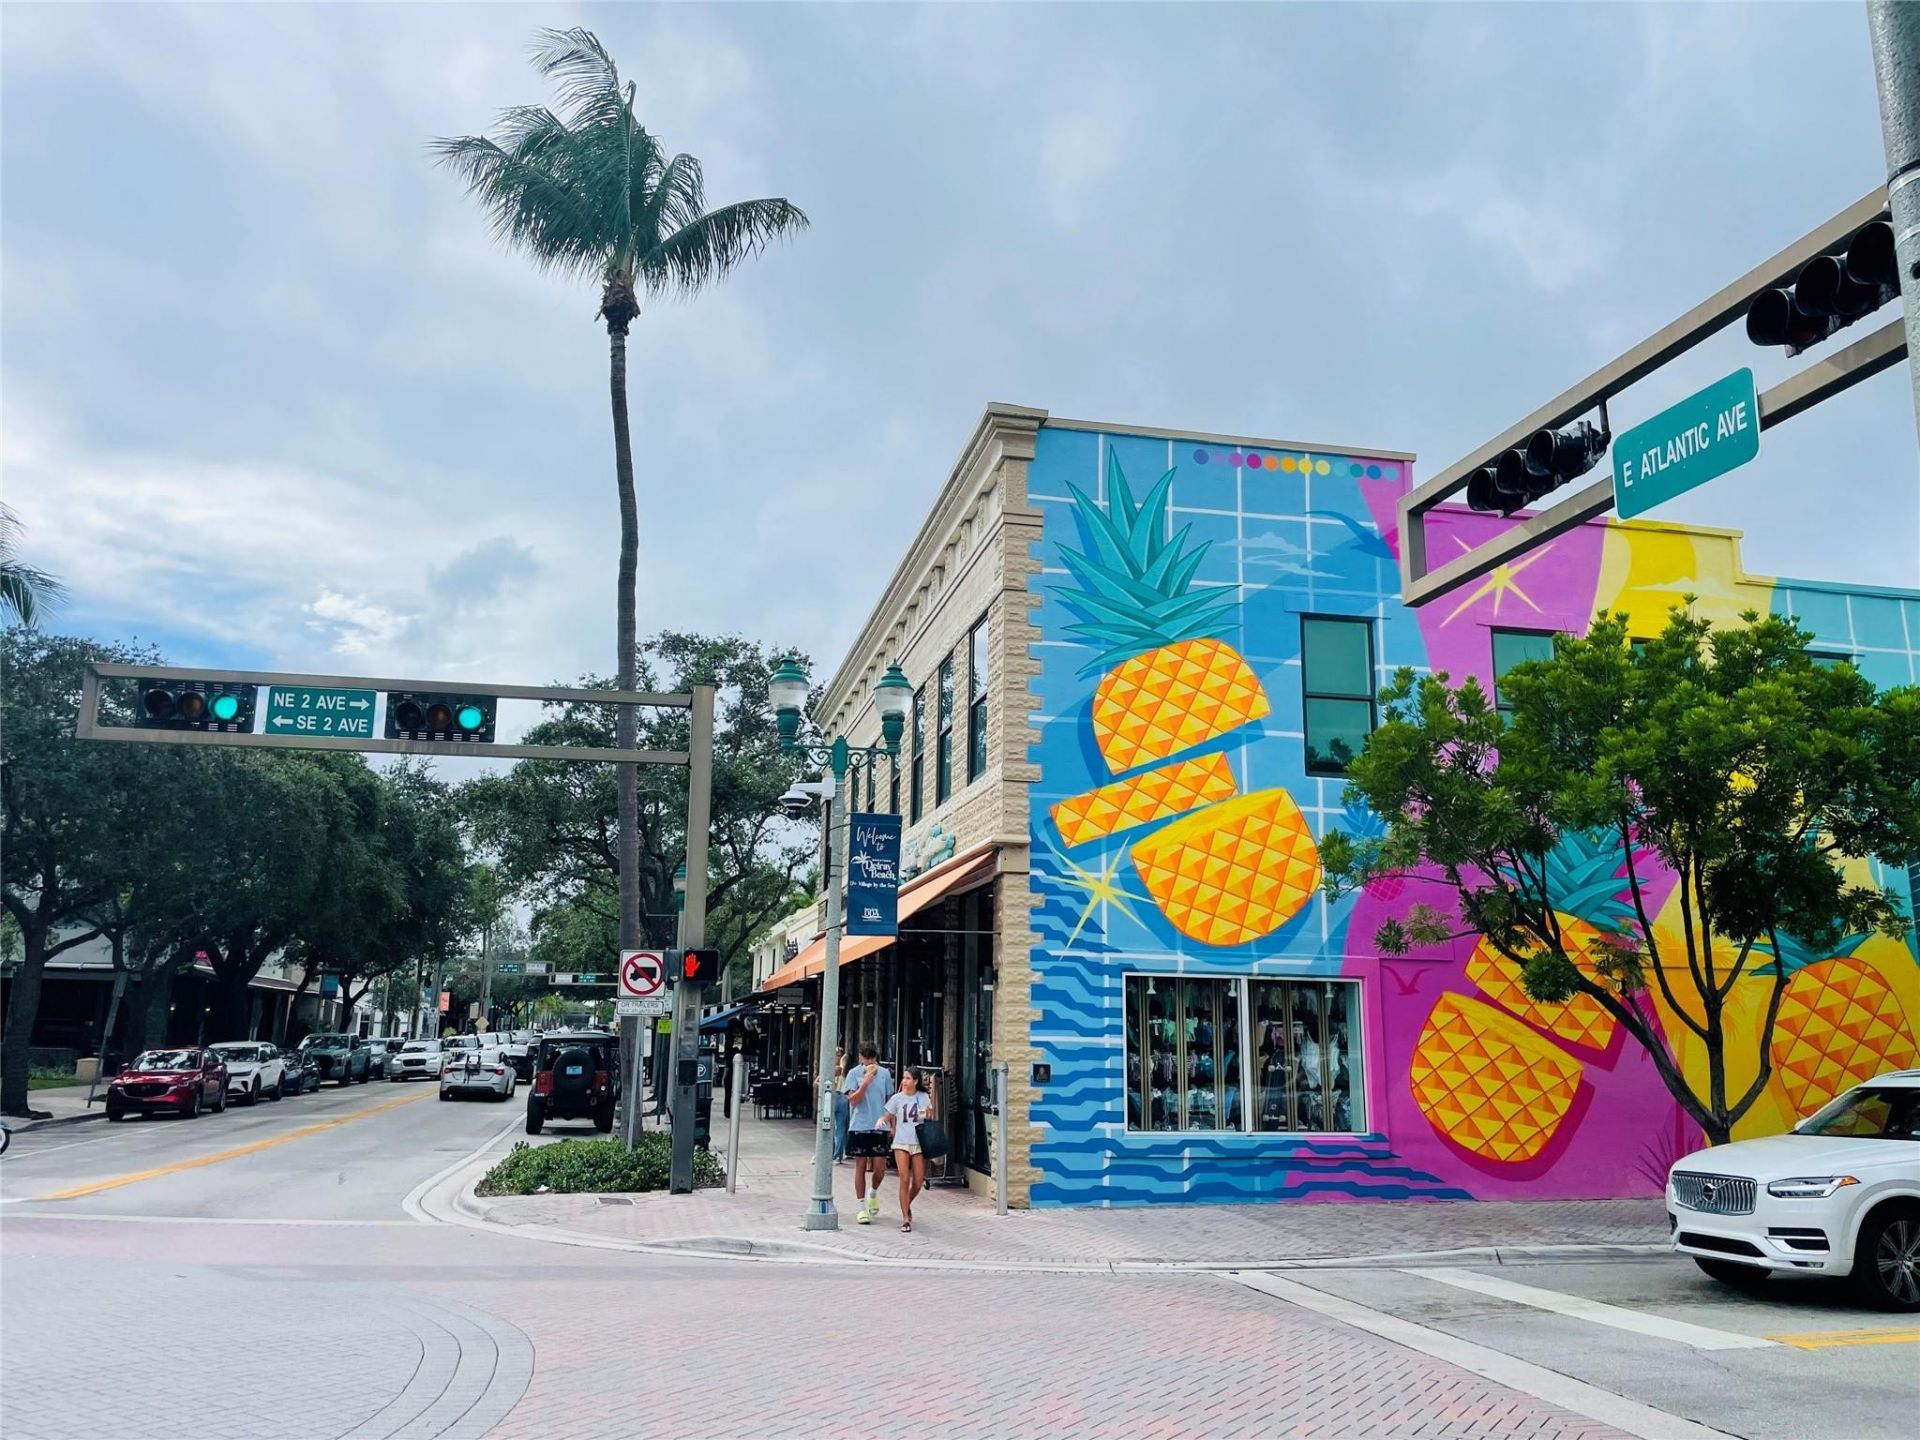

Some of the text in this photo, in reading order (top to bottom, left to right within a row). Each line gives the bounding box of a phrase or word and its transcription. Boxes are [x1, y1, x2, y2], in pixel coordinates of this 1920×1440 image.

[1623, 401, 1748, 488] E ATLANTIC AVE
[274, 692, 346, 711] NE 2 AVE
[296, 715, 368, 733] SE 2 AVE
[856, 826, 897, 848] Welcome
[875, 842, 885, 852] to
[865, 860, 896, 871] Delray
[869, 869, 897, 880] Beach
[902, 1103, 919, 1123] 14
